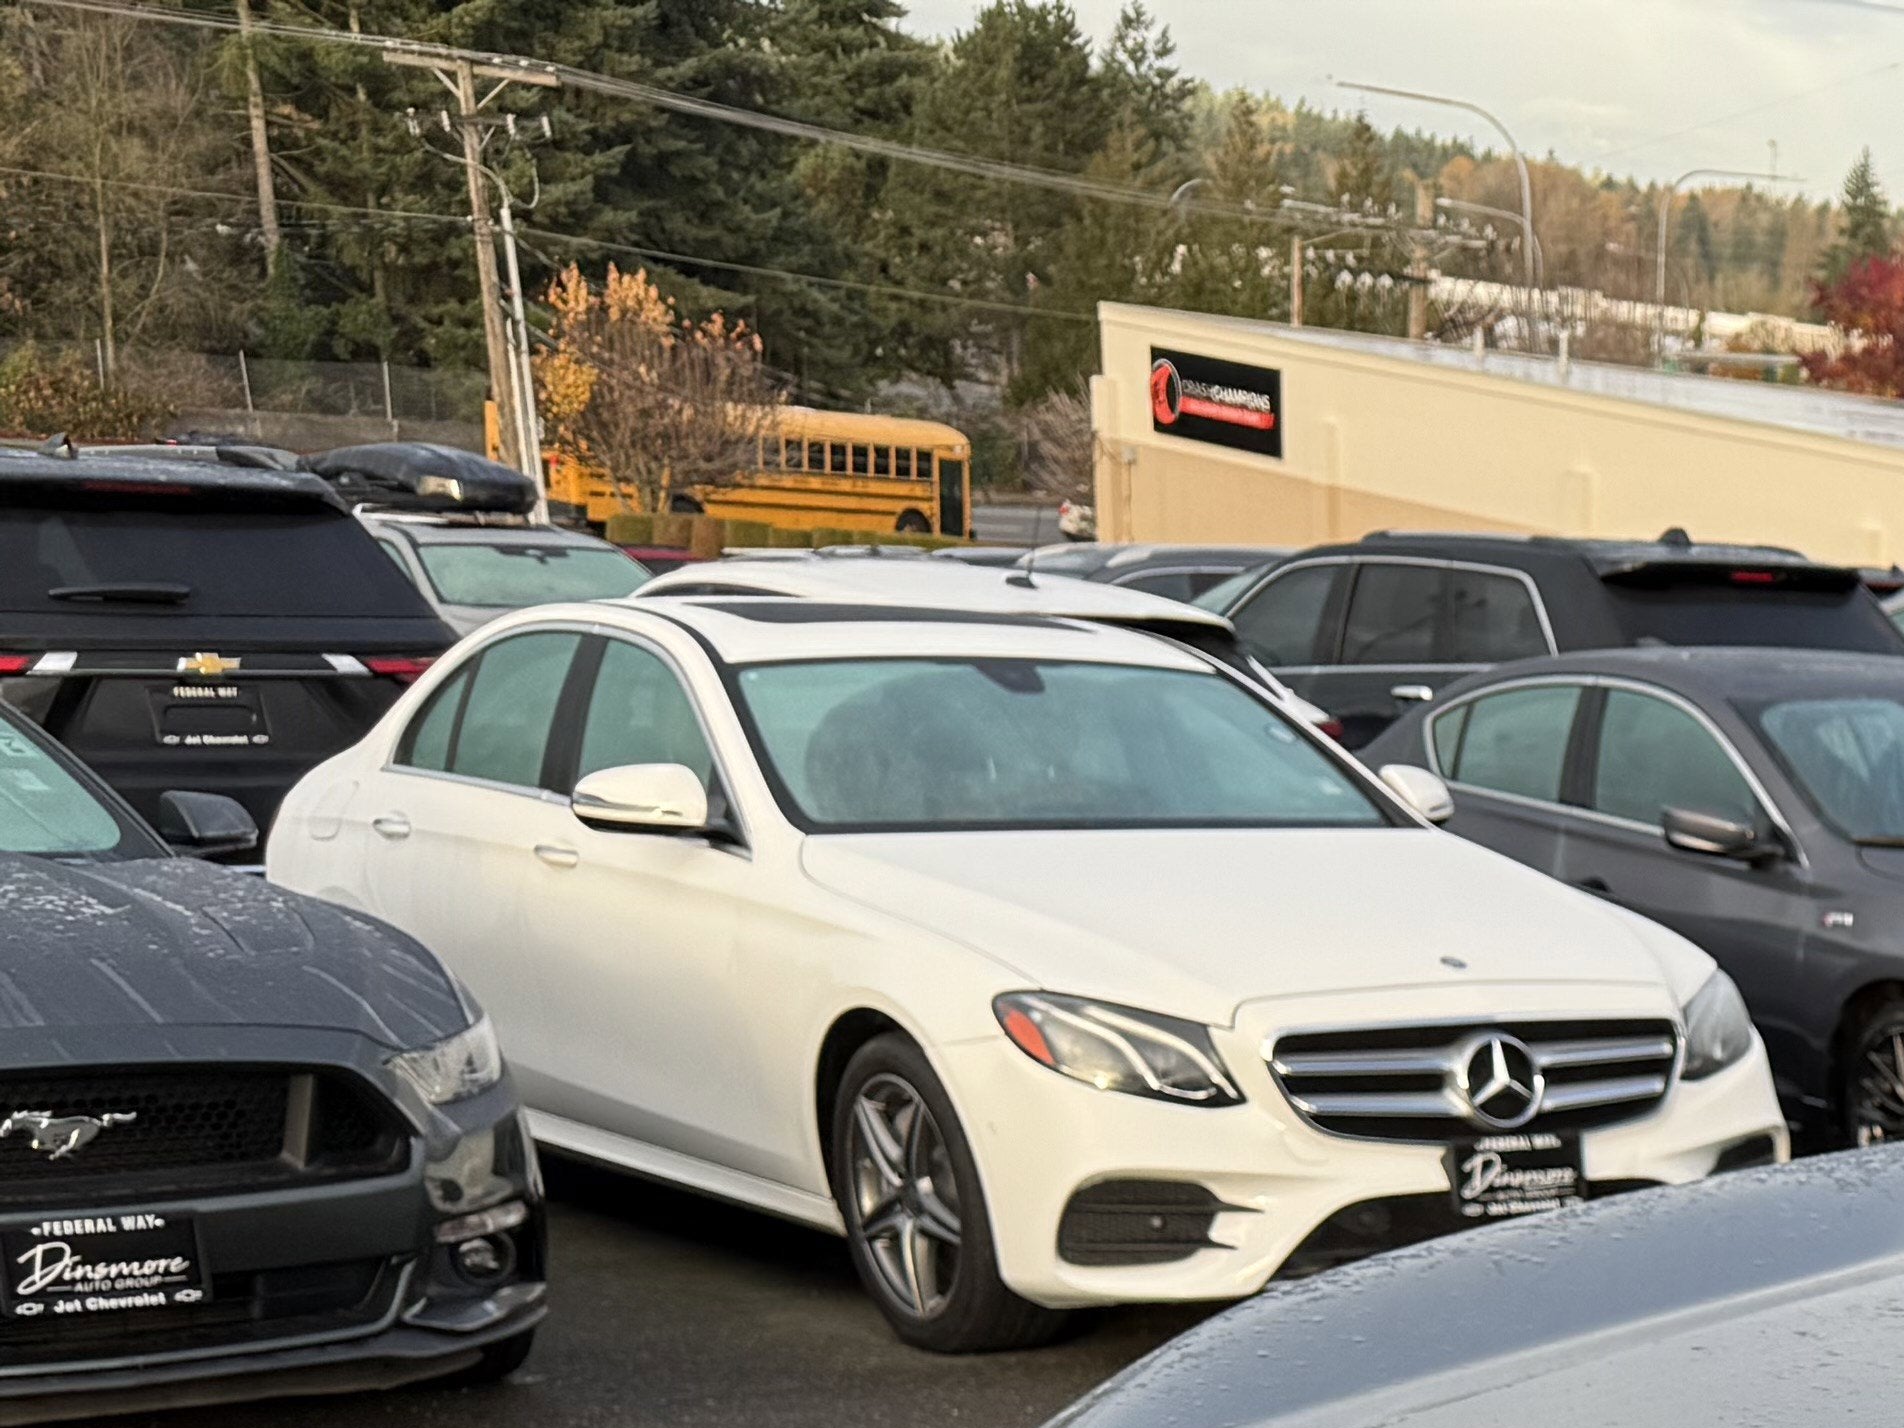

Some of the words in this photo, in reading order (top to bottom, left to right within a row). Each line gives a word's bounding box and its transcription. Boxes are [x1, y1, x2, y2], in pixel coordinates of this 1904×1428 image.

[42, 1217, 117, 1237] FEDERAL
[120, 1214, 156, 1231] WAY
[17, 1241, 190, 1295] Dinsmore
[74, 1279, 112, 1293] AUTO
[114, 1275, 163, 1290] GROUP
[53, 1298, 83, 1314] Jet
[85, 1292, 167, 1311] Chevrolet
